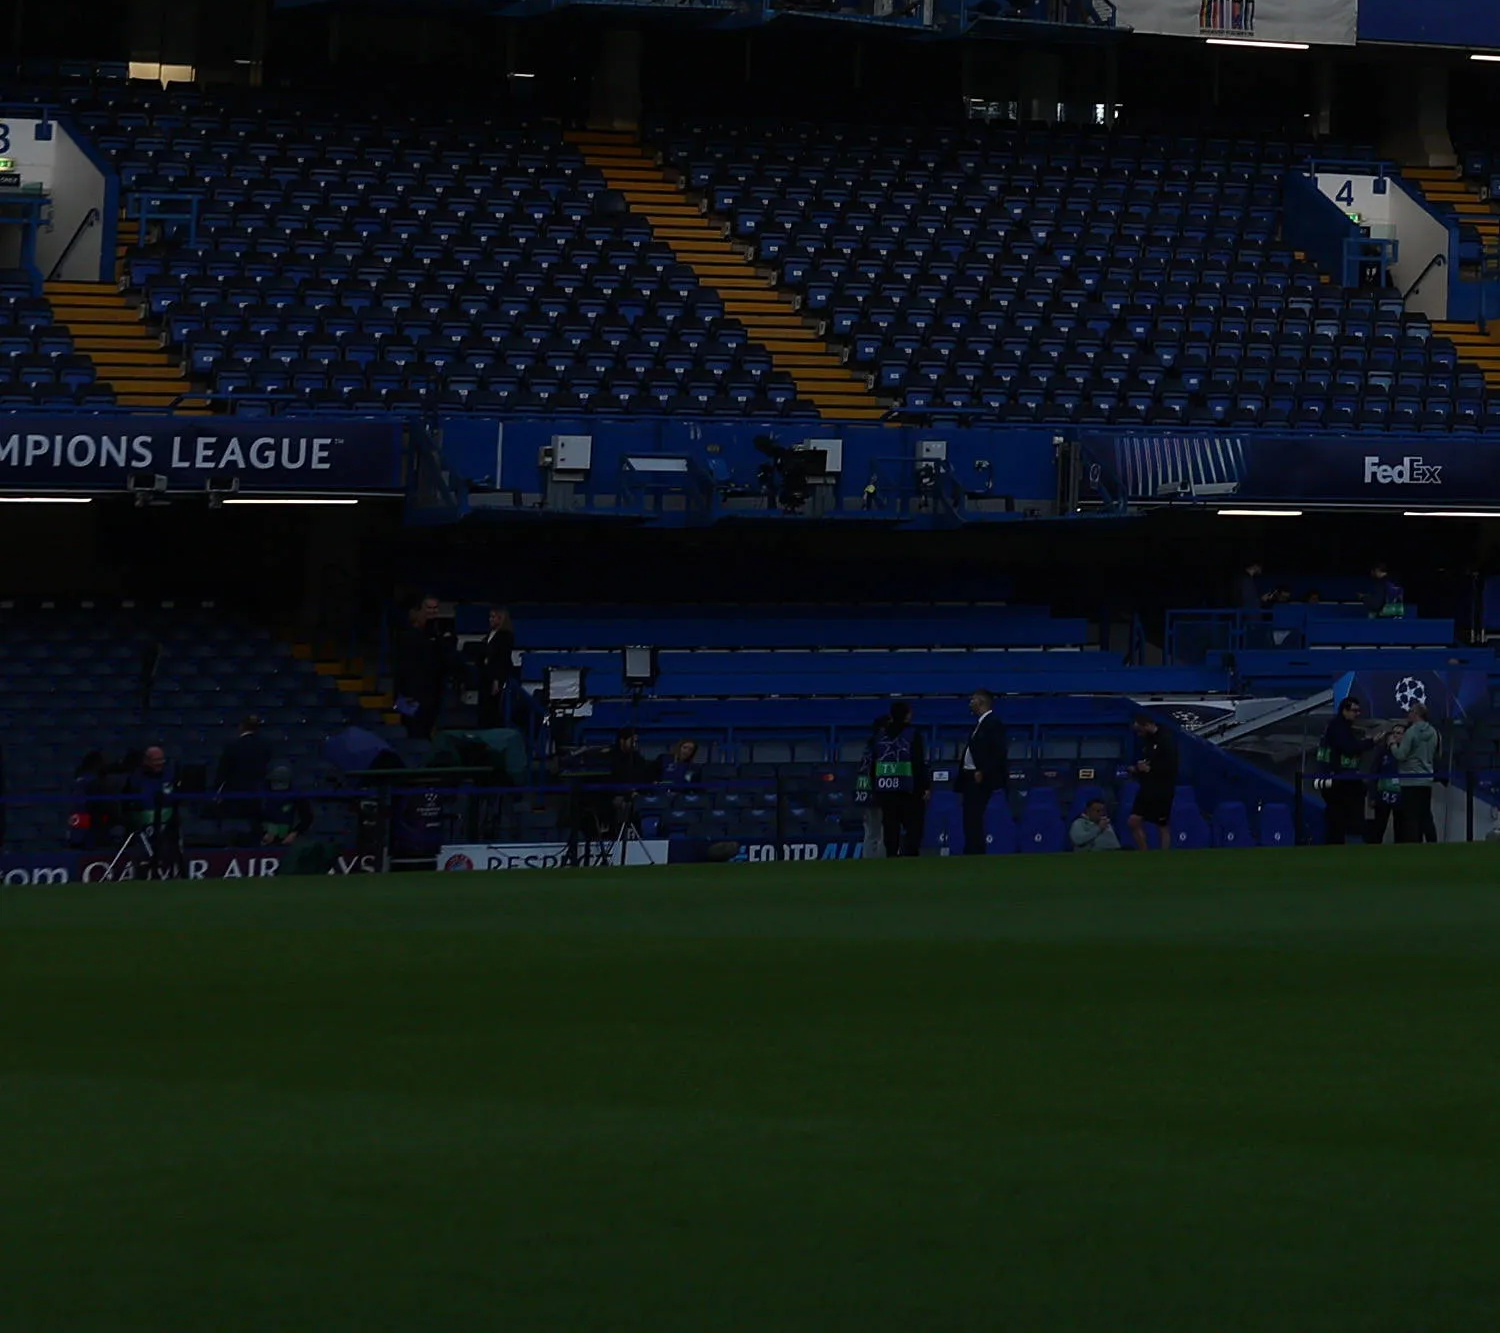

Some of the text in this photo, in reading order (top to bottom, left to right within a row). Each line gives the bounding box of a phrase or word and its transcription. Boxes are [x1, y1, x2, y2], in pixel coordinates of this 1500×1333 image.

[1335, 180, 1354, 207] 4
[1363, 455, 1443, 484] FedEx
[877, 777, 900, 789] 008
